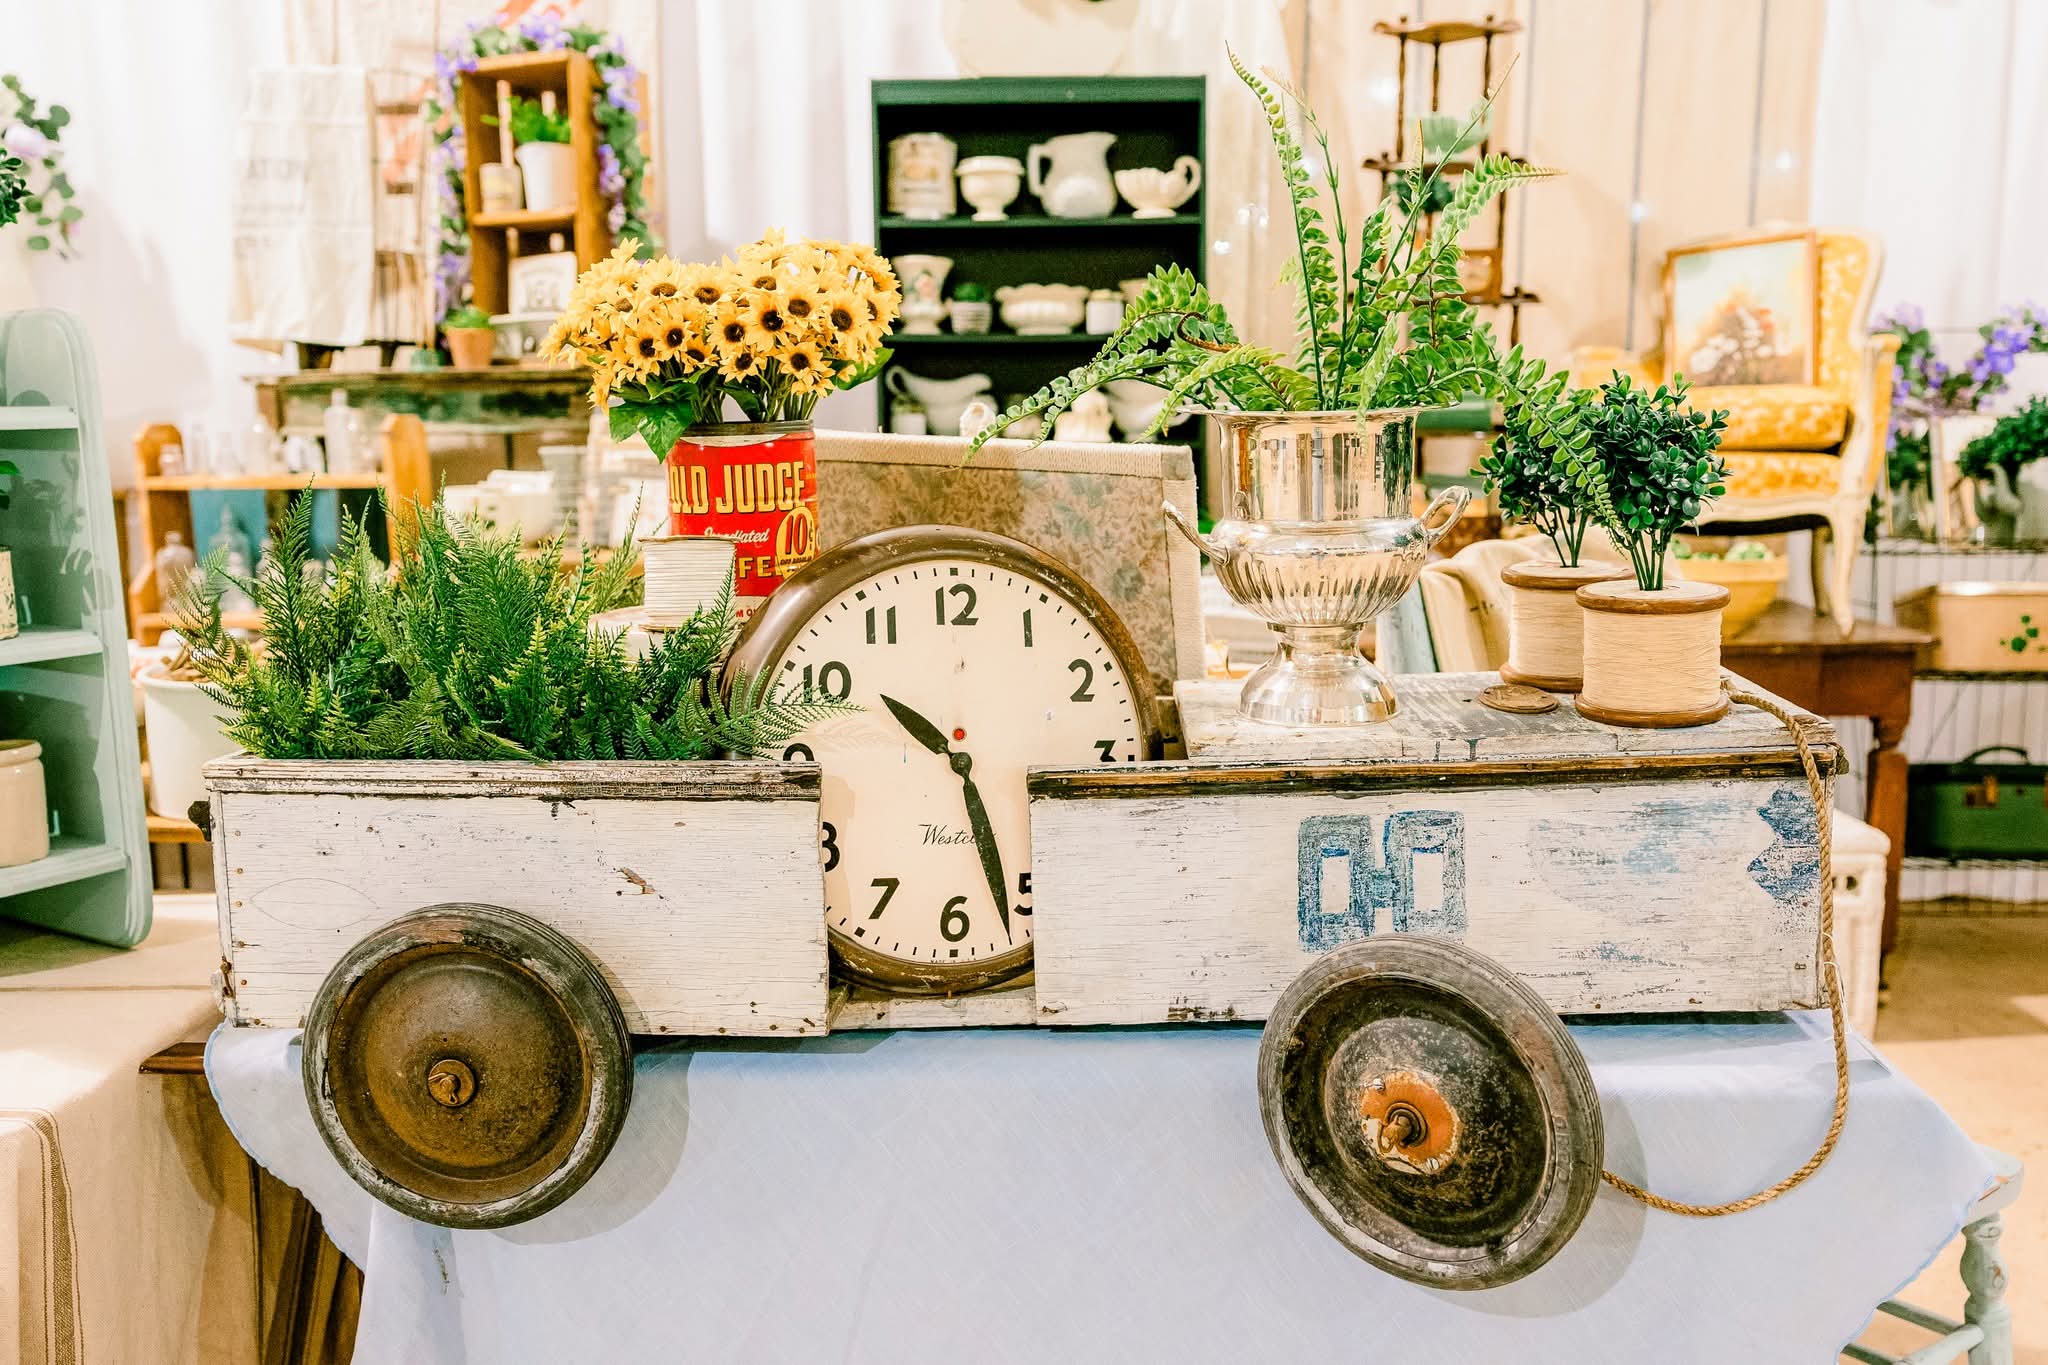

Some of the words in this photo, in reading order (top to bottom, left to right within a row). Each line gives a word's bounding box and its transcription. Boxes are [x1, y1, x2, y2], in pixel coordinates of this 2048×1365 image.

[716, 461, 805, 513] JUDGE
[866, 605, 897, 645] 11
[935, 583, 979, 626] 12
[1023, 608, 1033, 648] 1
[803, 661, 852, 704] 10
[1068, 658, 1095, 702] 2
[868, 878, 900, 920] 7
[940, 895, 970, 943] 6
